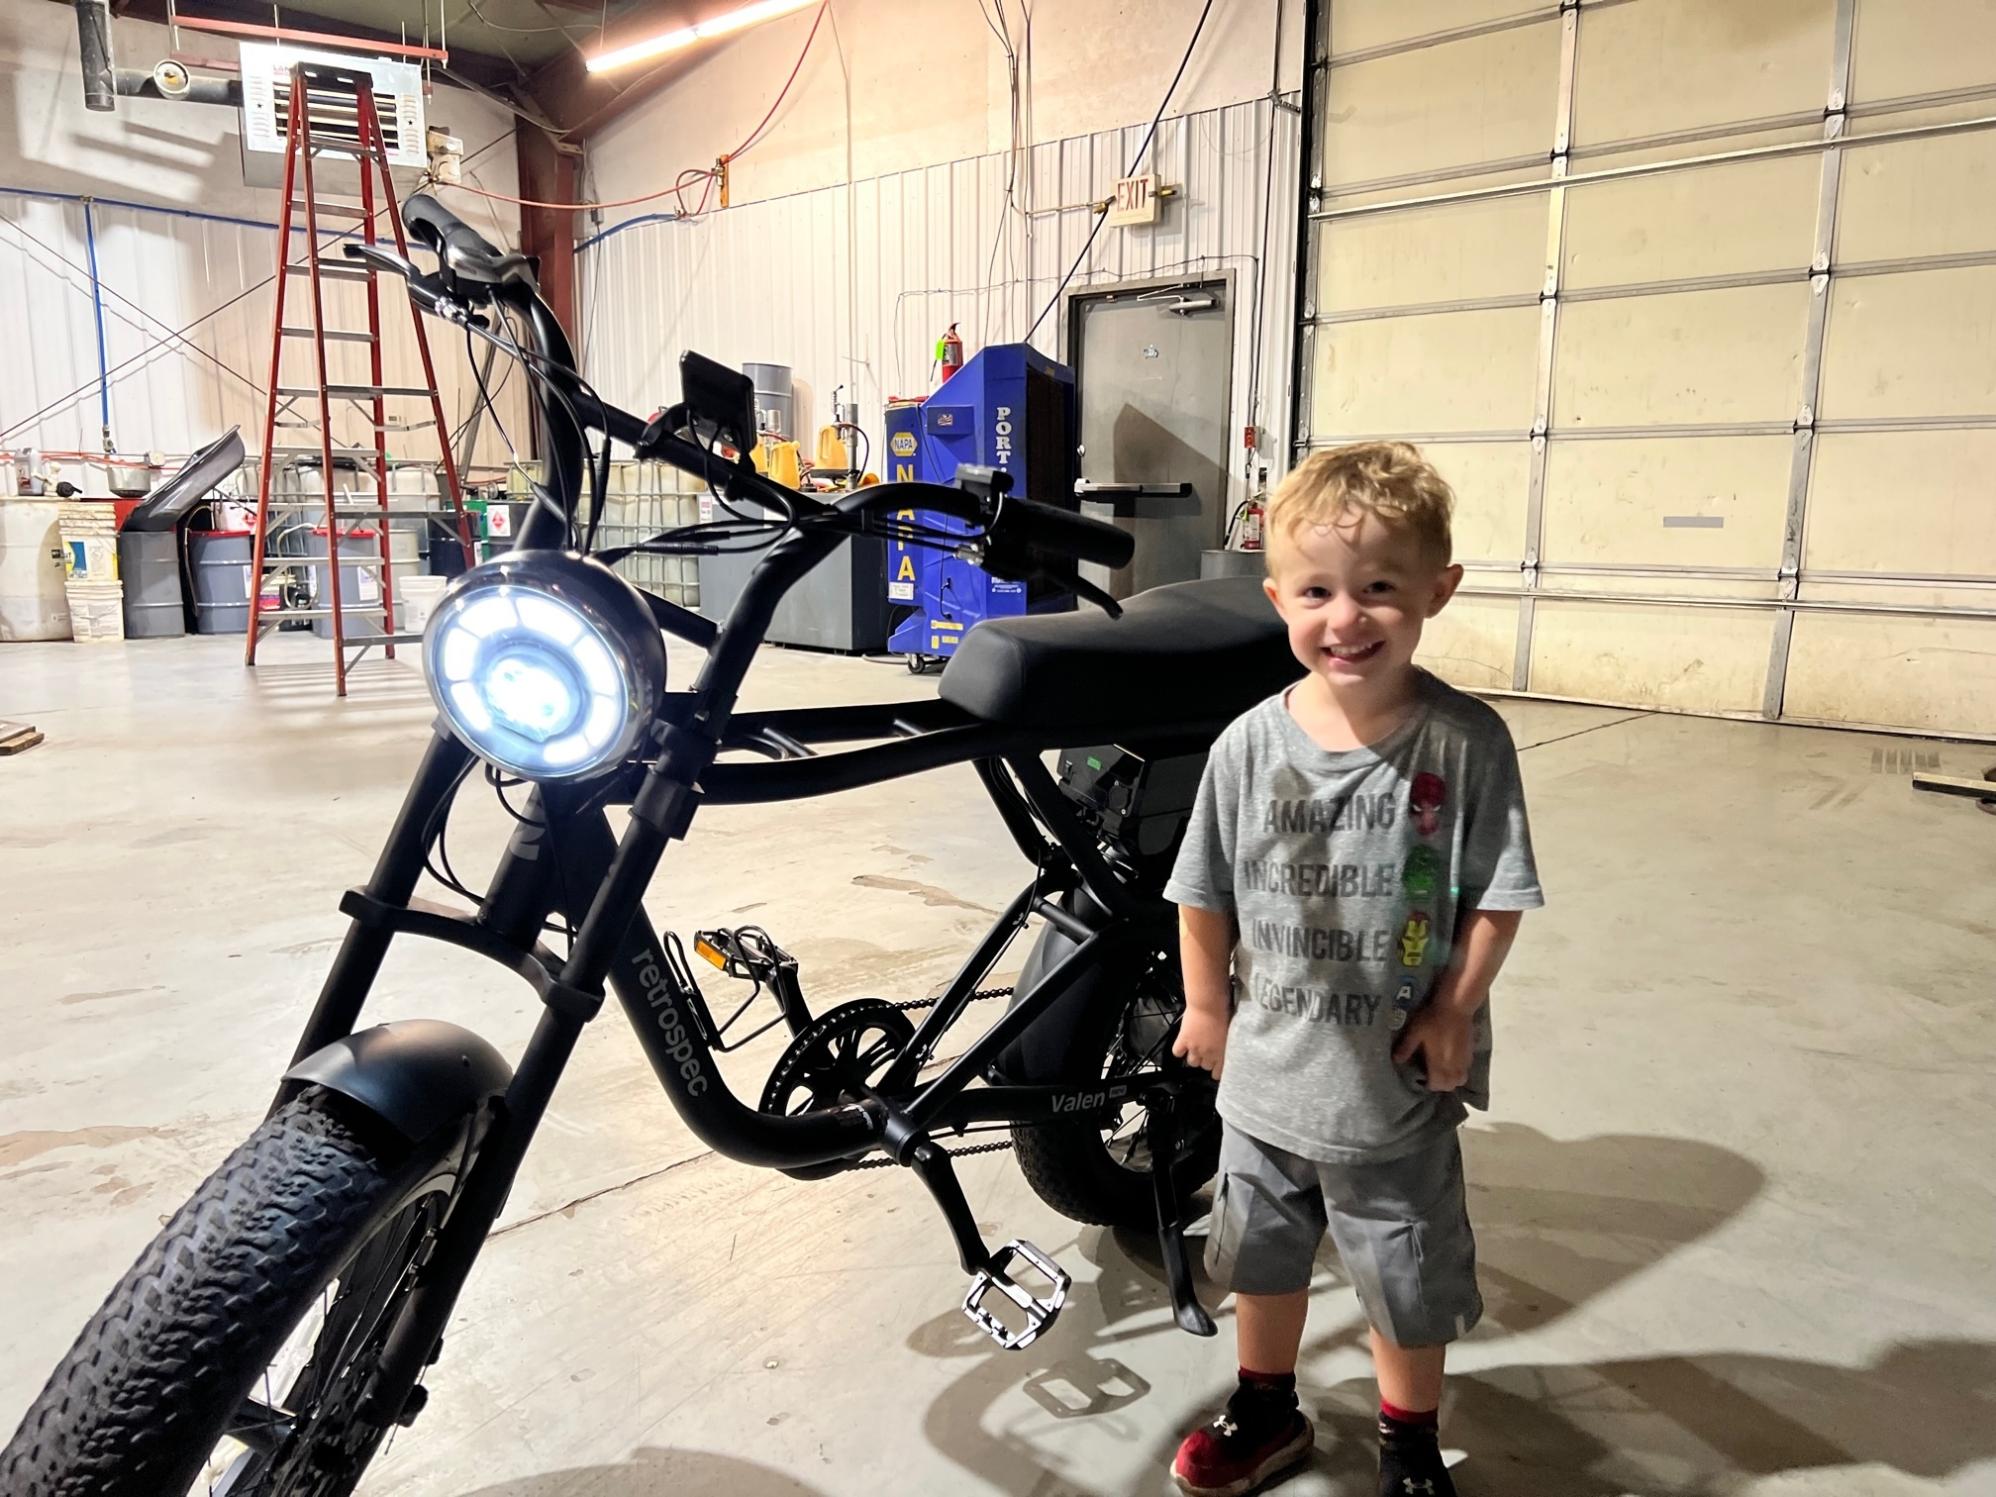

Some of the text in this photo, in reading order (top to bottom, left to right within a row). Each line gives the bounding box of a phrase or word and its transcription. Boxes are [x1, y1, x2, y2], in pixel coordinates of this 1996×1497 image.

[1117, 179, 1148, 212] EXIT
[894, 437, 914, 451] NAPA
[1264, 793, 1395, 835] AMAZING
[1244, 860, 1394, 898] INCREDIBLE
[1252, 920, 1390, 962] INVINCIBLE
[631, 948, 708, 1097] retrospec
[1051, 1092, 1105, 1112] Valen
